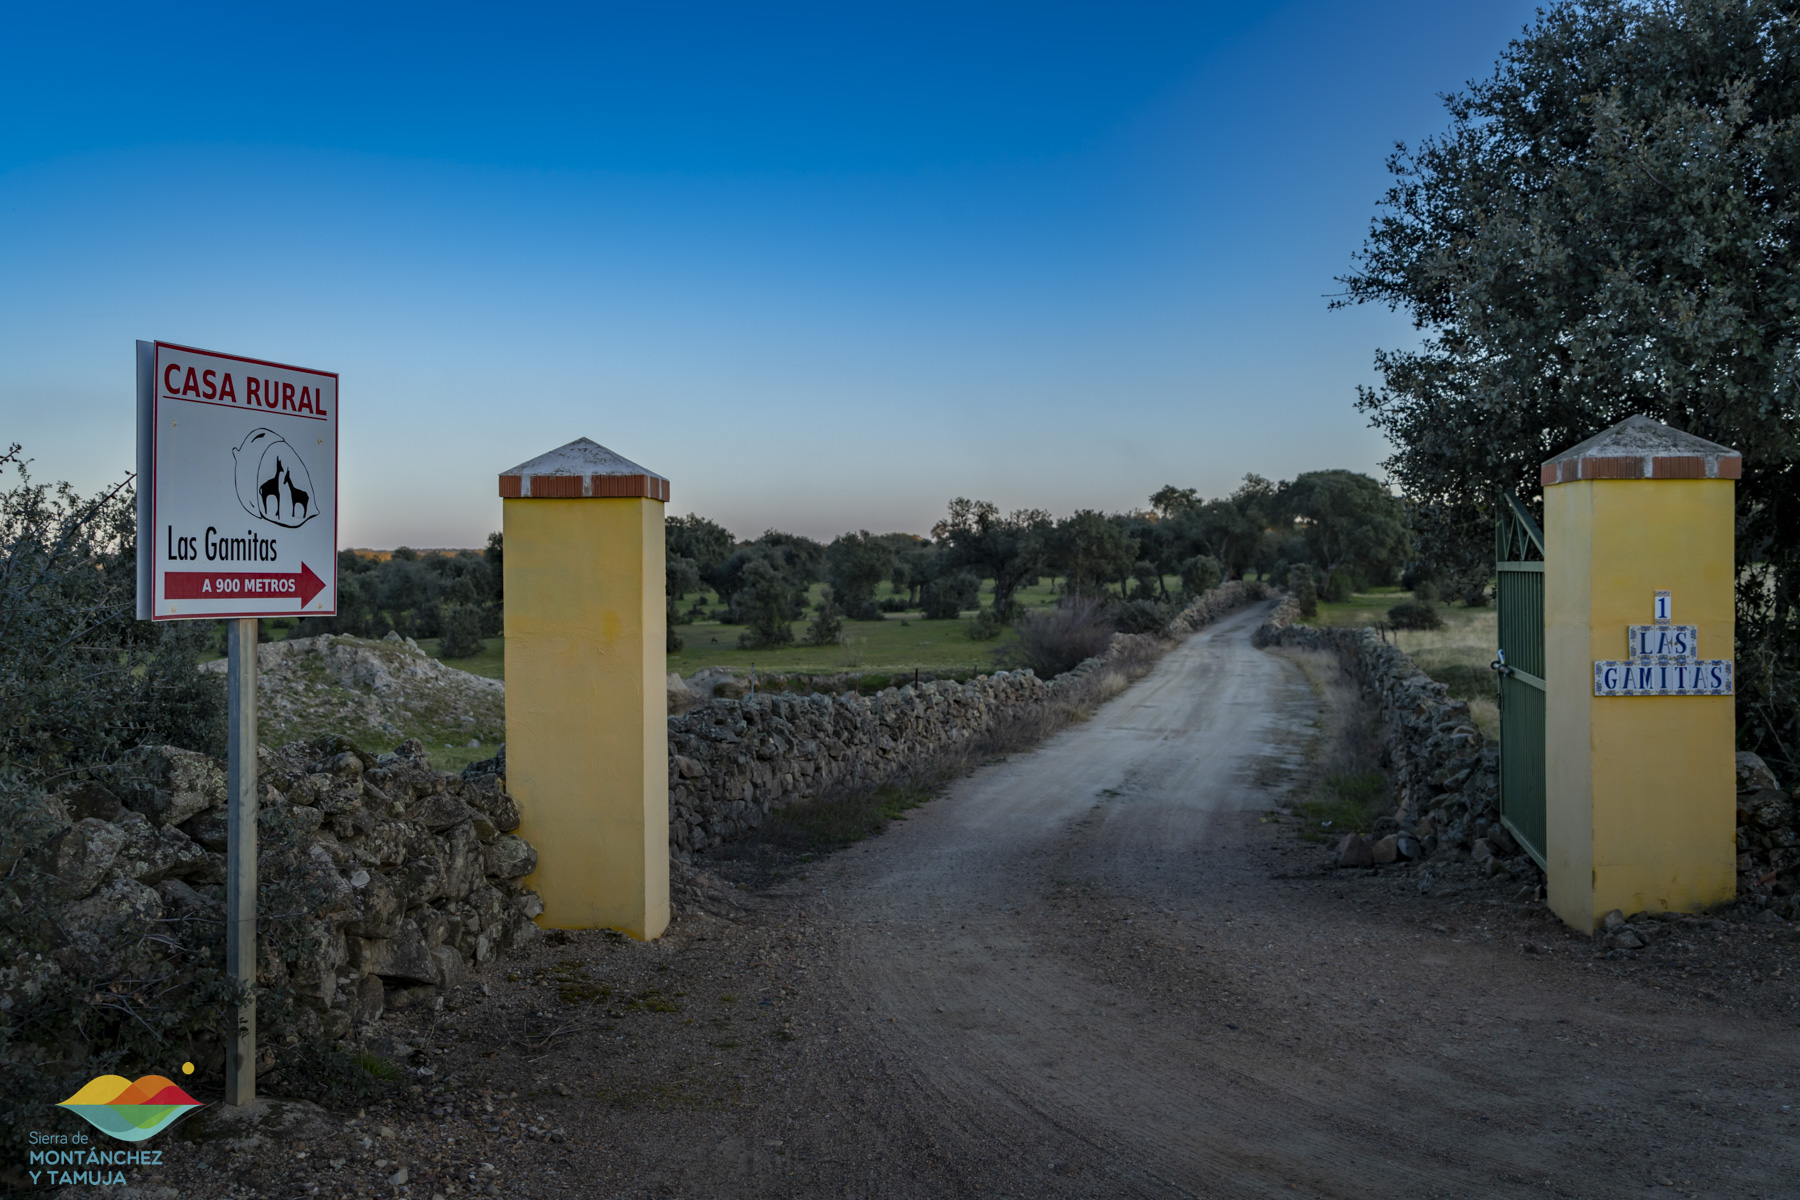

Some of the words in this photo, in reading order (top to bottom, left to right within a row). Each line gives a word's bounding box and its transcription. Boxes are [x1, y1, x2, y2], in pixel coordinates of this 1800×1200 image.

[164, 363, 236, 403] CASA
[246, 376, 327, 416] RURAL
[168, 525, 197, 561] Las
[205, 526, 277, 562] Gamitas
[202, 579, 212, 592] A
[216, 578, 240, 592] 900
[244, 578, 296, 592] METROS
[1657, 597, 1668, 619] 1
[1639, 632, 1687, 655] LAS
[1604, 666, 1722, 689] GAMITAS
